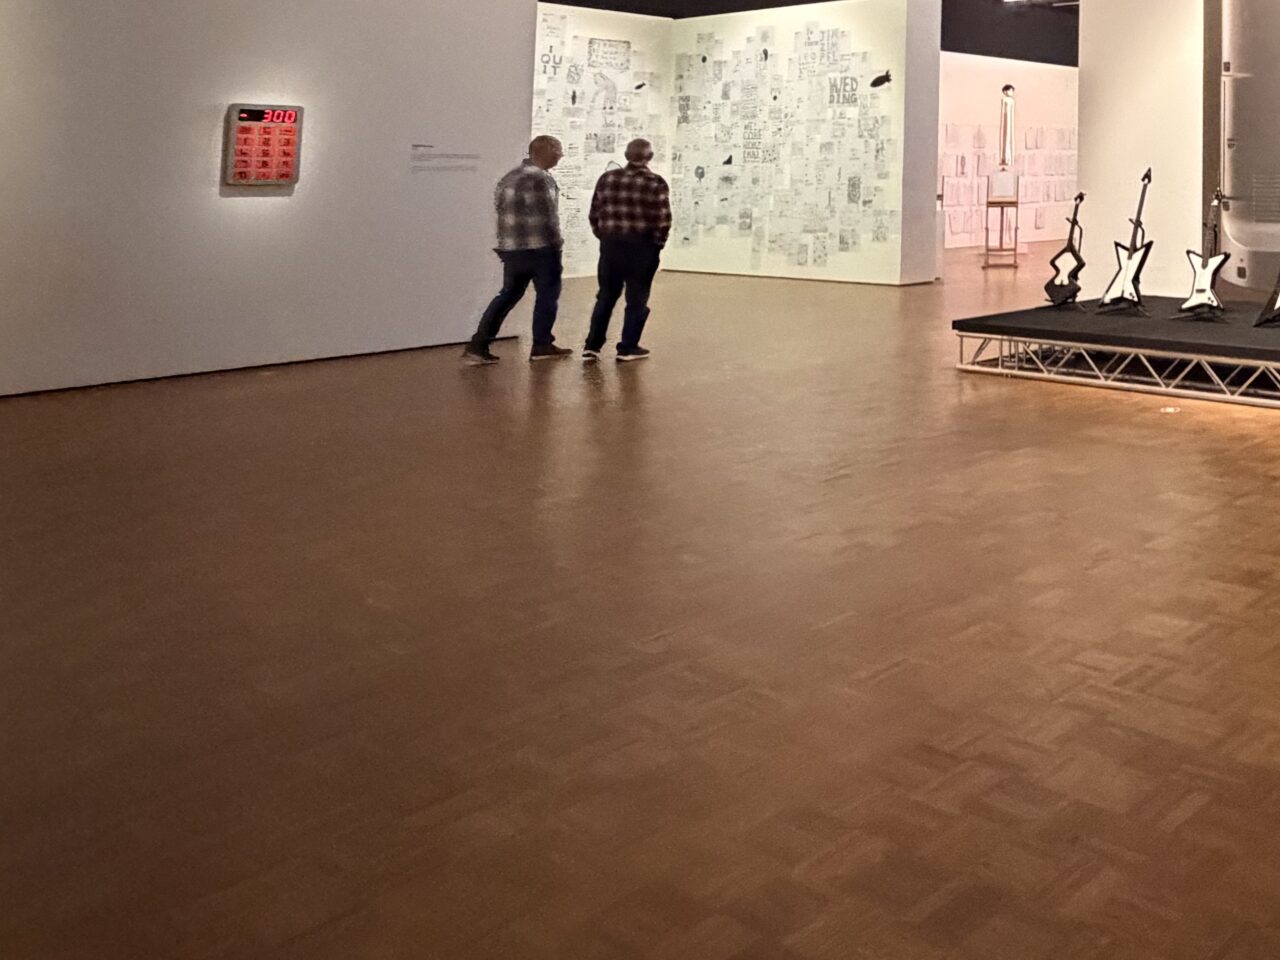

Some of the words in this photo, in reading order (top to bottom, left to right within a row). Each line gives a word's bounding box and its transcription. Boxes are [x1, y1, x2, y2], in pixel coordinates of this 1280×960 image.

[541, 53, 563, 65] QU
[542, 65, 562, 76] IT
[828, 76, 858, 93] WED
[828, 92, 858, 105] DING
[263, 109, 297, 124] 300
